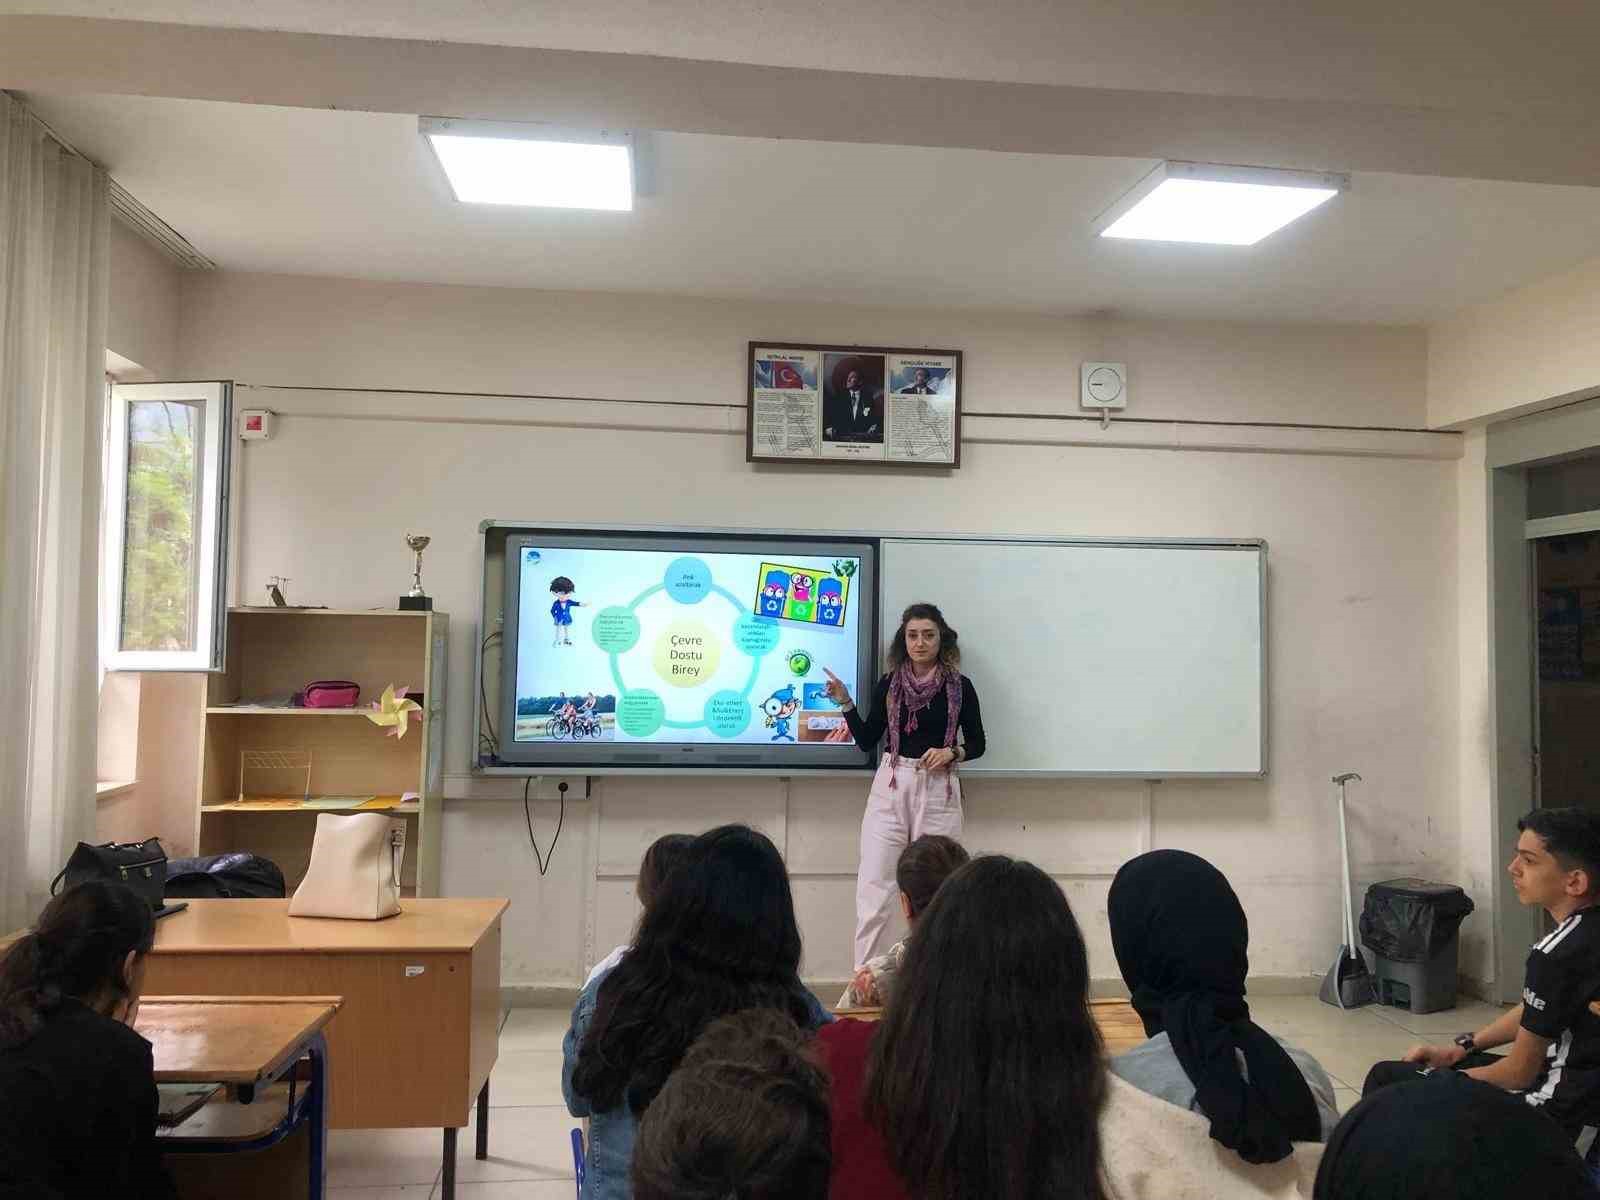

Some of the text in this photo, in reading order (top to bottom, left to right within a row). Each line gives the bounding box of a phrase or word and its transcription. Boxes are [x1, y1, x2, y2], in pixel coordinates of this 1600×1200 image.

[670, 634, 703, 648] Çevre
[670, 649, 703, 660] Dostu
[672, 664, 701, 677] Birey
